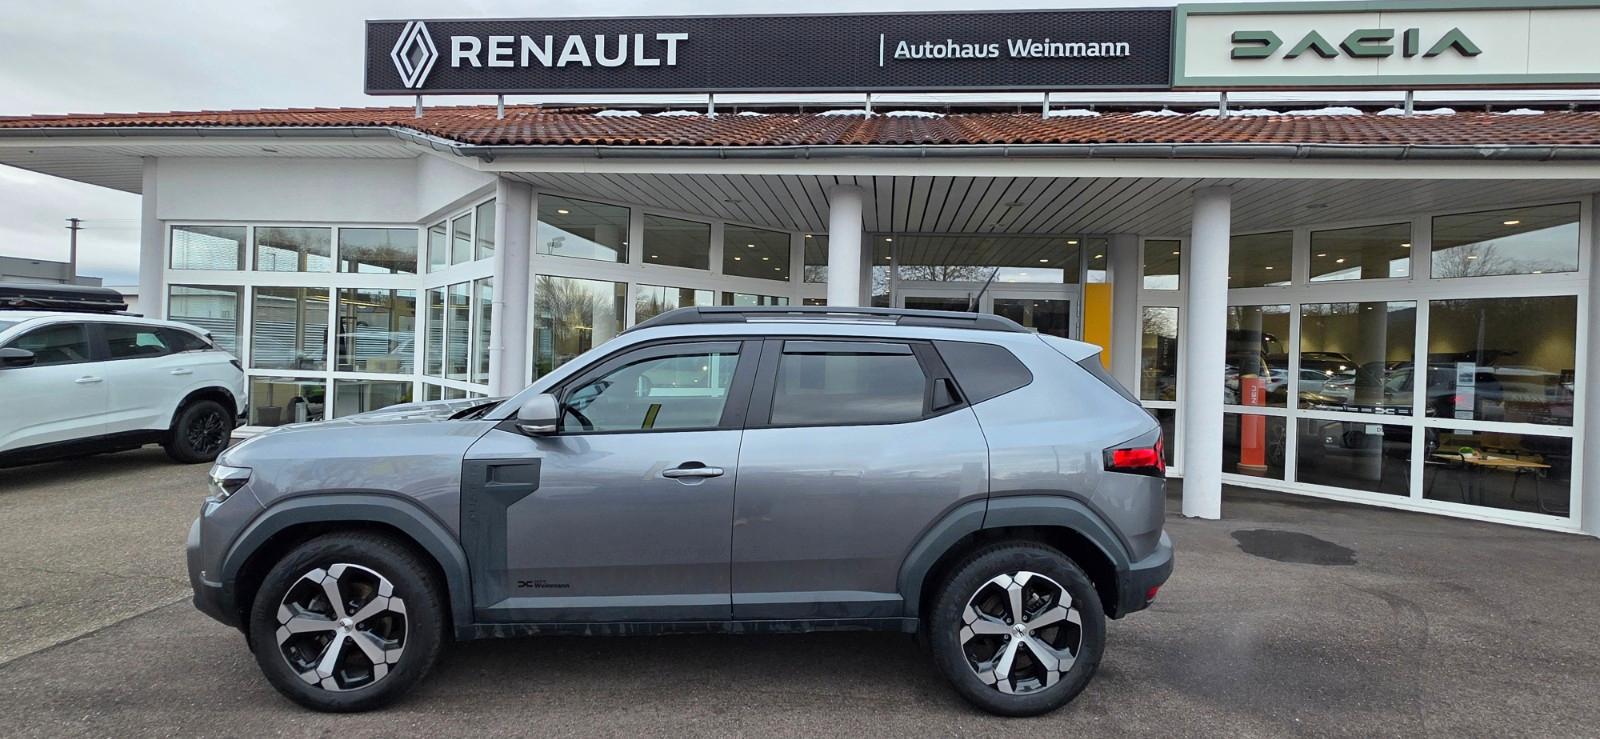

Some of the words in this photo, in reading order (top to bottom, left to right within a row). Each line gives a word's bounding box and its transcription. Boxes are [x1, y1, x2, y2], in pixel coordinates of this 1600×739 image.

[450, 33, 689, 67] RENAULT
[893, 39, 1000, 59] Autohaus
[1007, 38, 1131, 58] Weinmann
[1231, 27, 1483, 60] DACIA
